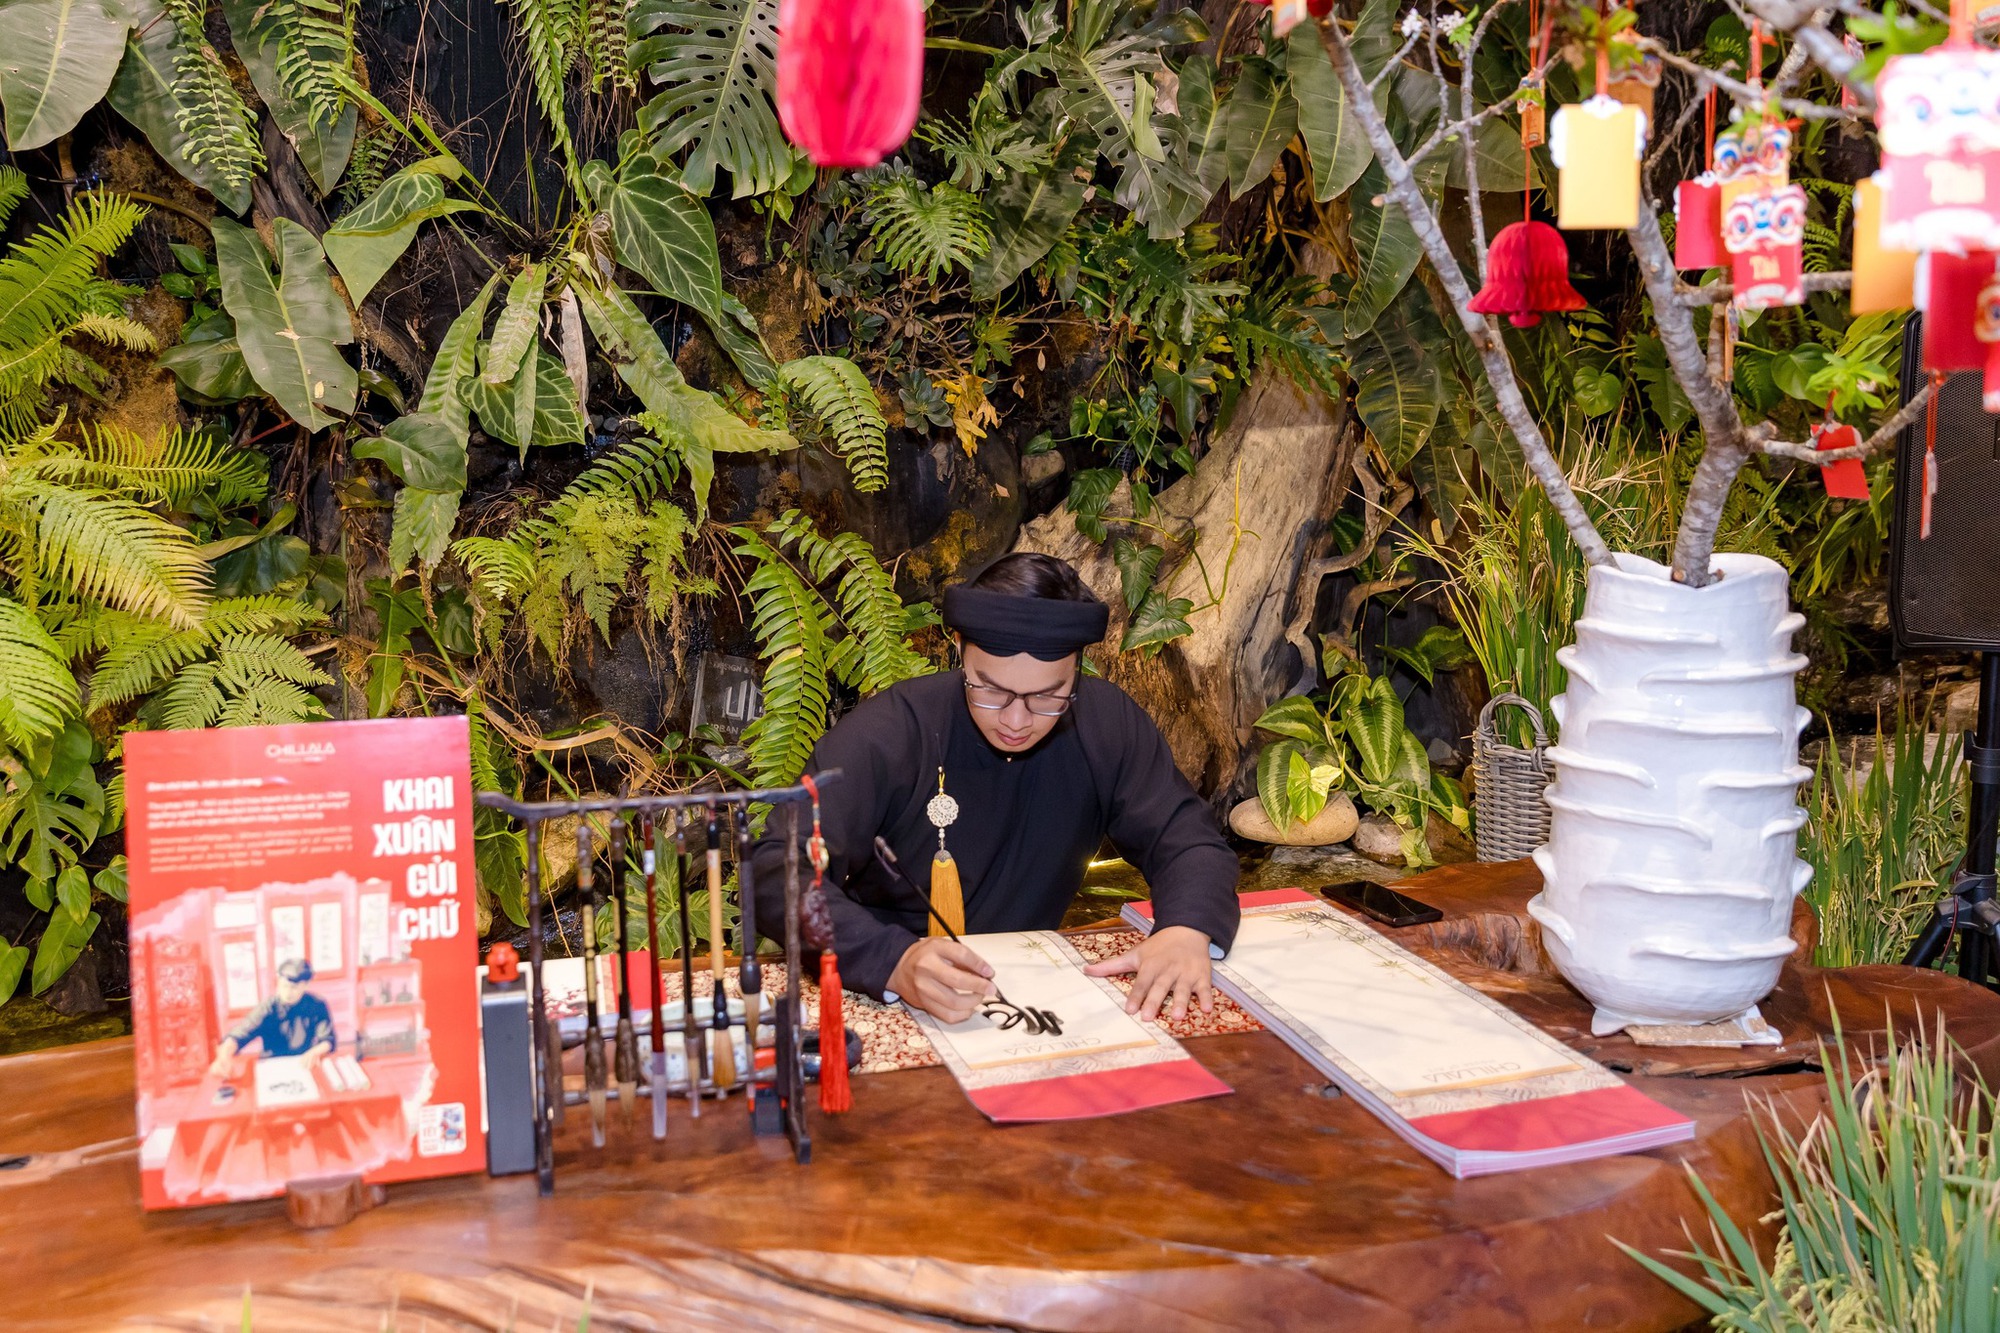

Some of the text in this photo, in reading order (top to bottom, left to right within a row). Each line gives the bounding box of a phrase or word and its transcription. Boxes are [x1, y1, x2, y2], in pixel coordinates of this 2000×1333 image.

[706, 722, 739, 735] RBAN
[265, 742, 336, 757] CHILLALA
[383, 776, 454, 812] KHAI
[372, 815, 456, 857] XUÂN
[399, 899, 460, 940] CHỮ
[1004, 1038, 1101, 1055] CHILLALA
[1422, 1062, 1520, 1083] CHILLALA
